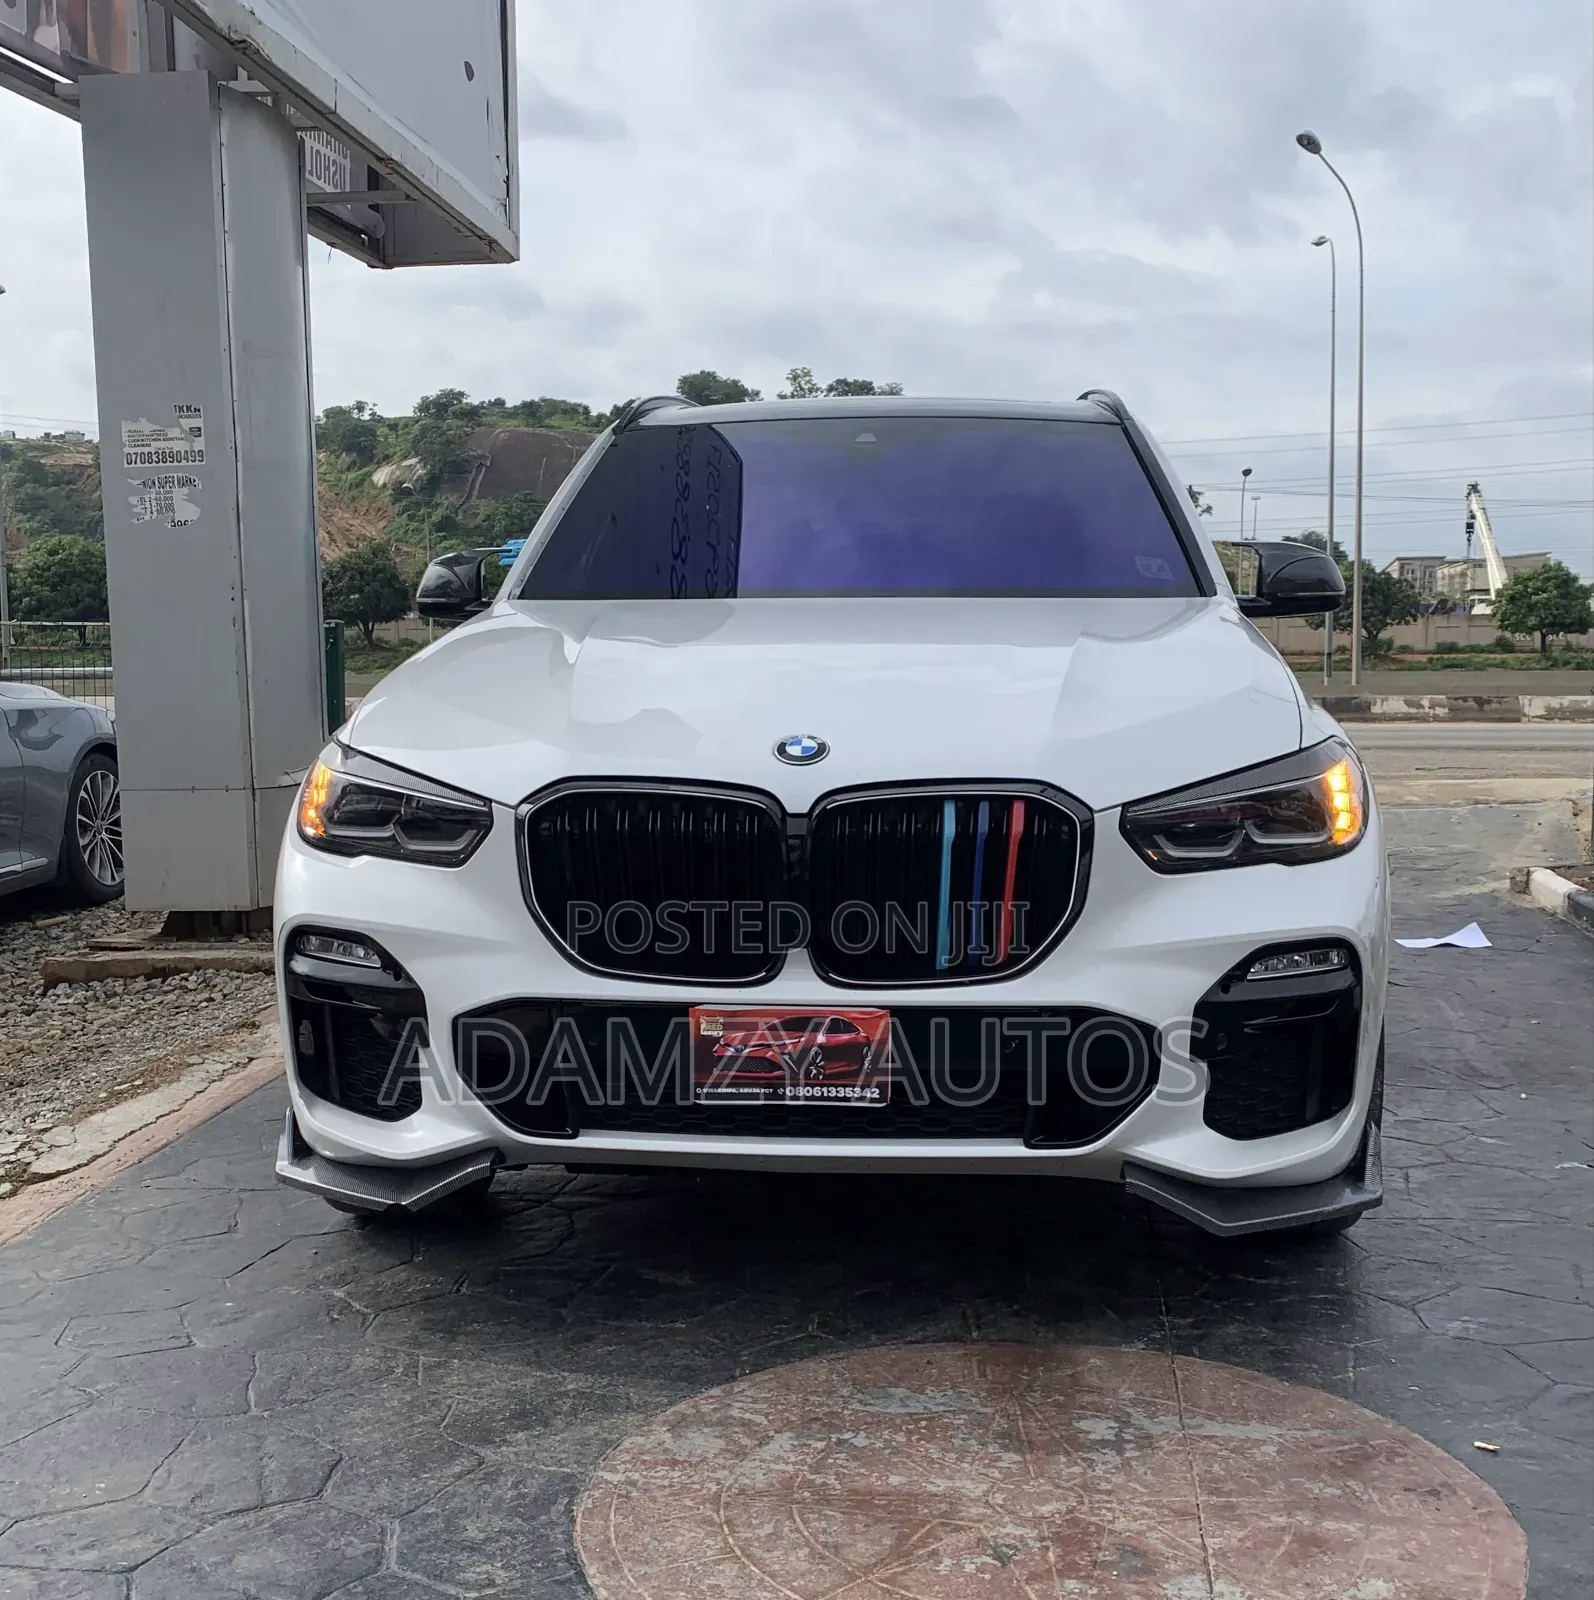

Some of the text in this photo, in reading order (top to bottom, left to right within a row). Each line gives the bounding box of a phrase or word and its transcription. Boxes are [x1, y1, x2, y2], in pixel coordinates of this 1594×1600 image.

[126, 450, 204, 465] 07083890499
[157, 475, 176, 490] SUPER
[786, 1087, 879, 1098] 08061335342
